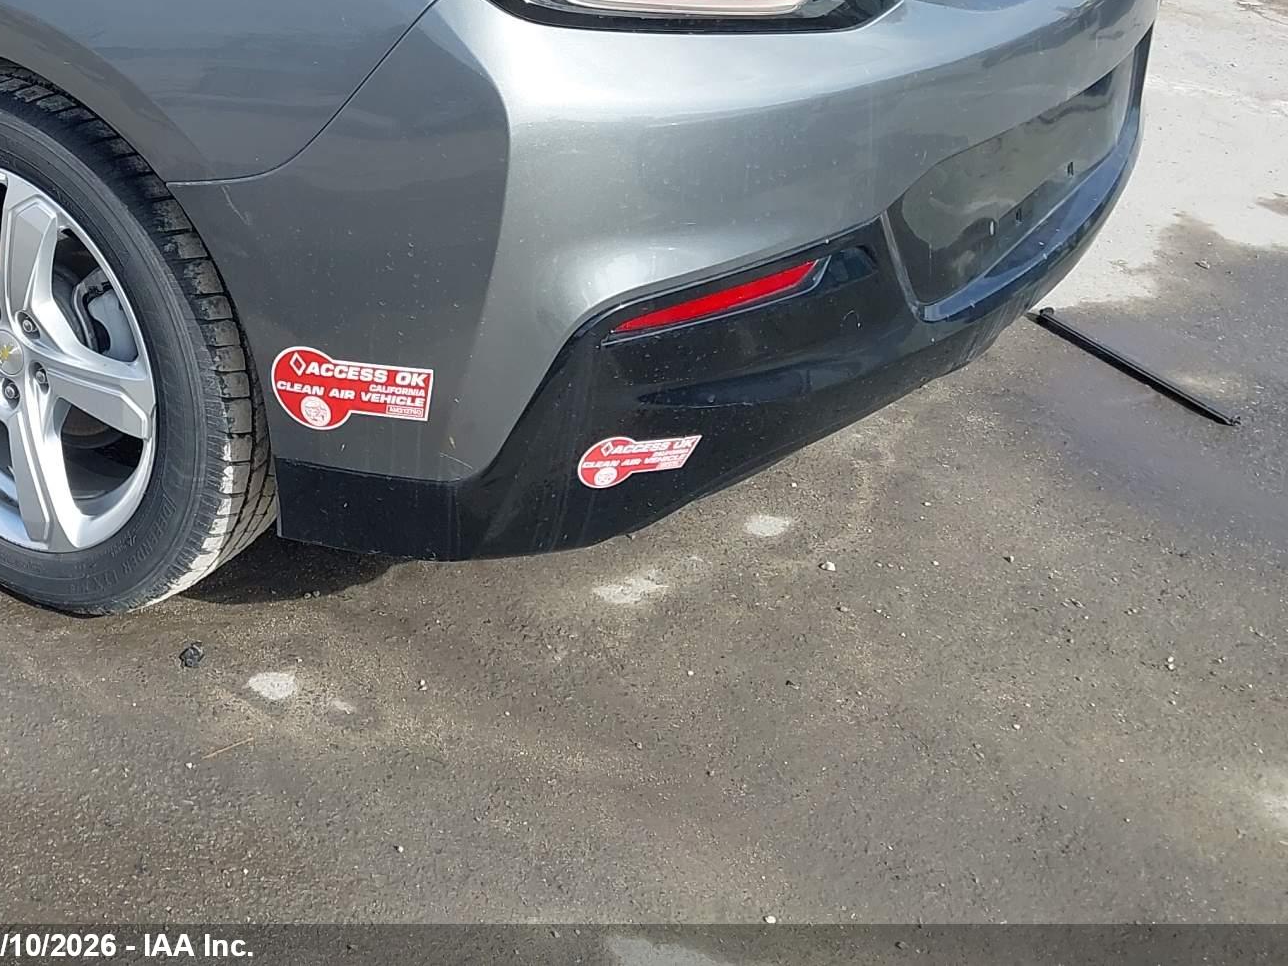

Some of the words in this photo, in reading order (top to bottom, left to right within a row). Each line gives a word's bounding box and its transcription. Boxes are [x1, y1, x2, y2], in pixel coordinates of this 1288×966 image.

[305, 361, 388, 383] ACCESS
[395, 371, 429, 387] OK
[276, 380, 324, 396] CLEAN
[328, 388, 355, 400] AIR
[360, 391, 426, 407] VEHICLE
[369, 384, 426, 397] CALIFORNIA
[611, 441, 671, 455] ACCESS
